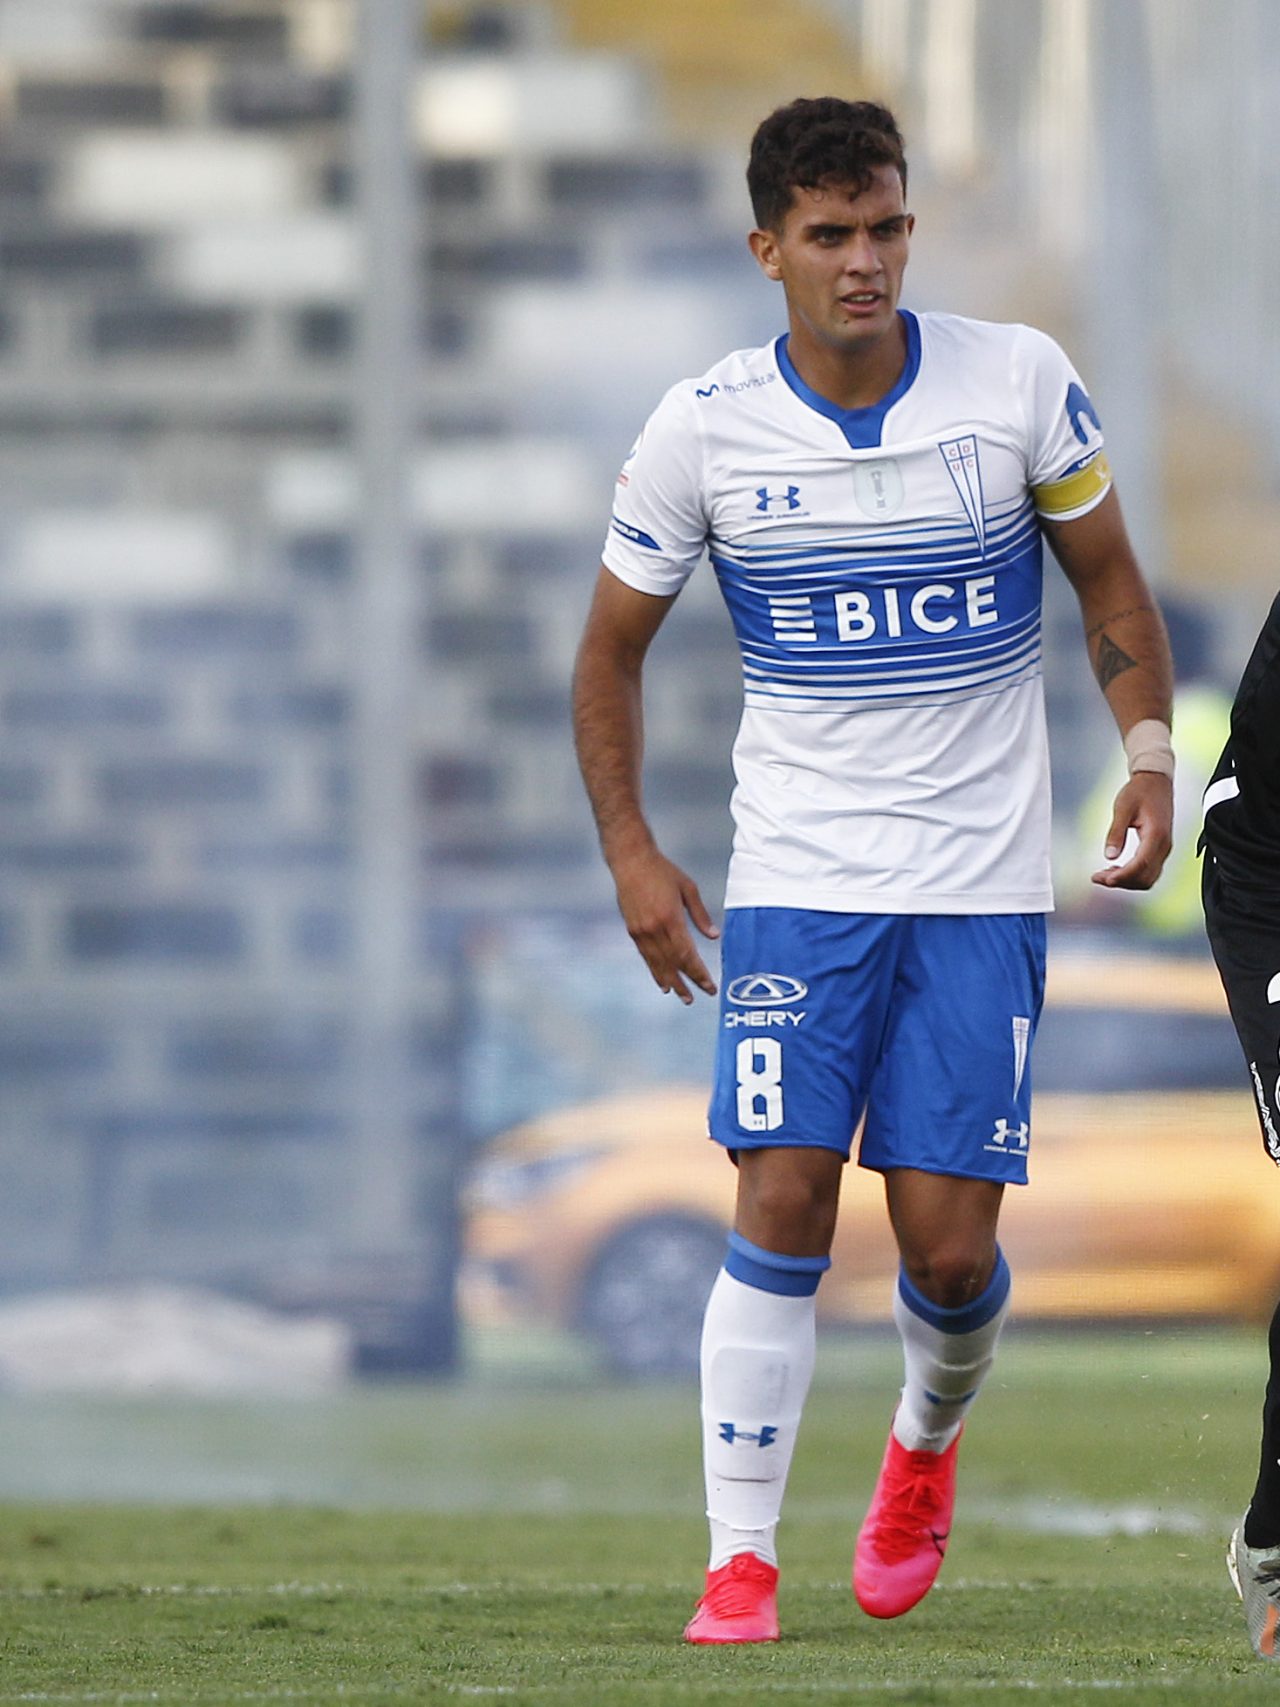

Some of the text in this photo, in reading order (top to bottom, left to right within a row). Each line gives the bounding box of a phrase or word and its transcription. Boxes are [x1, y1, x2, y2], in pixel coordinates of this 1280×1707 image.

[834, 575, 998, 642] BICE
[724, 1010, 806, 1029] CHERY
[737, 1037, 784, 1131] 8
